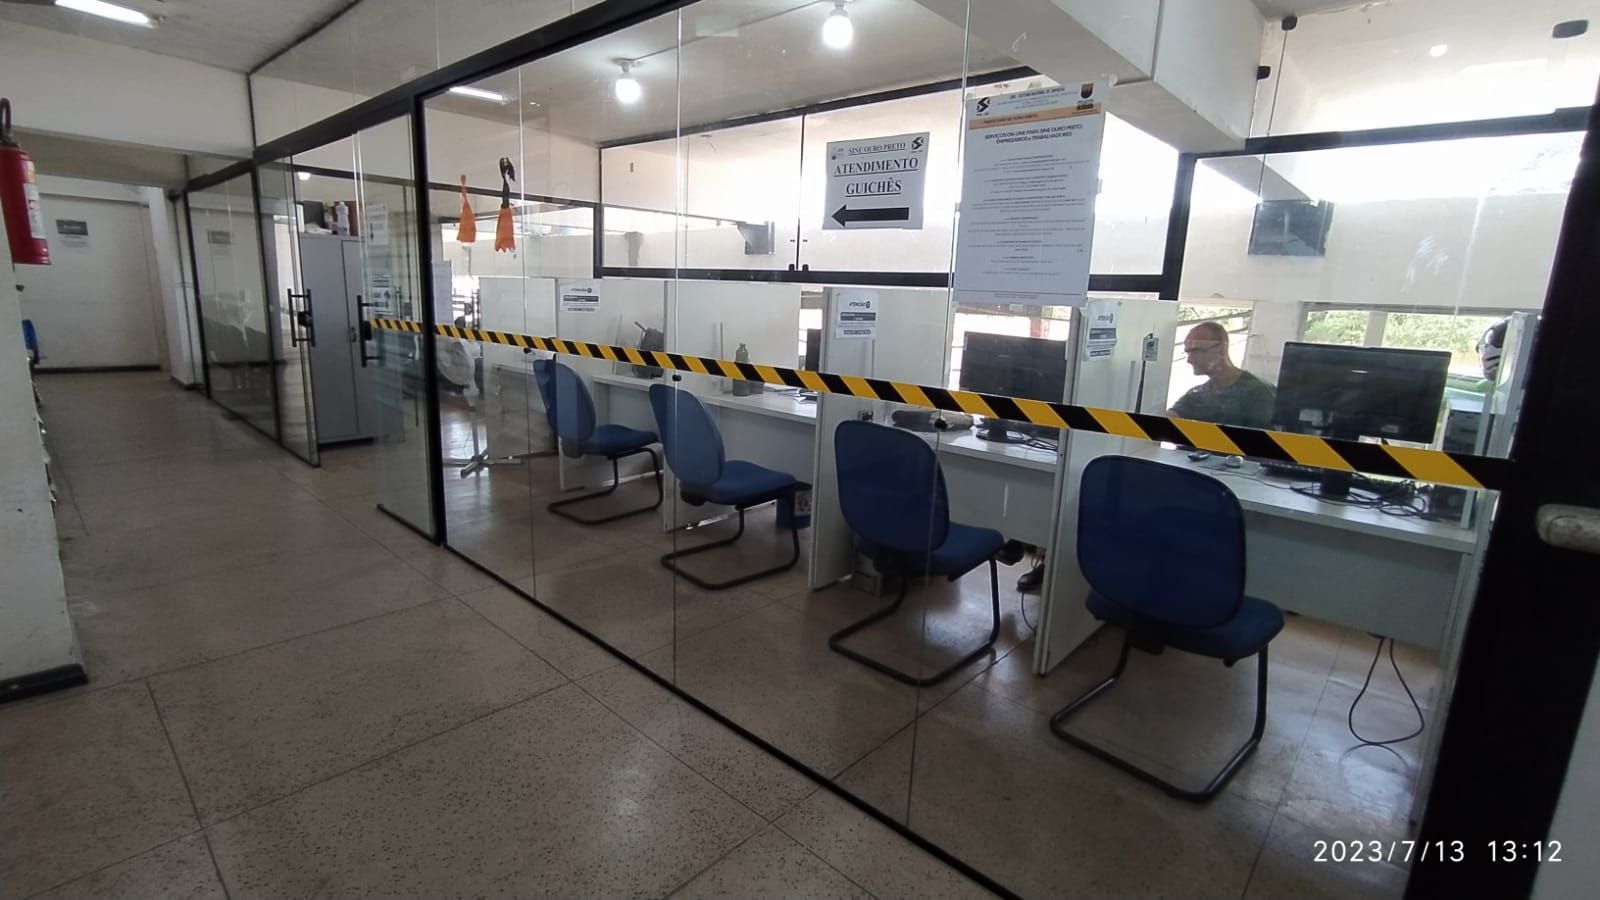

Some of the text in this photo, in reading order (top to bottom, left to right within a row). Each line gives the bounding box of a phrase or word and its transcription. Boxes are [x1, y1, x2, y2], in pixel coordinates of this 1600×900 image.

[848, 146, 862, 154] SINE
[863, 143, 882, 152] OURO
[883, 142, 906, 150] PRETO
[834, 157, 919, 175] ATENDIMENTO
[846, 177, 902, 195] GUICHÊS
